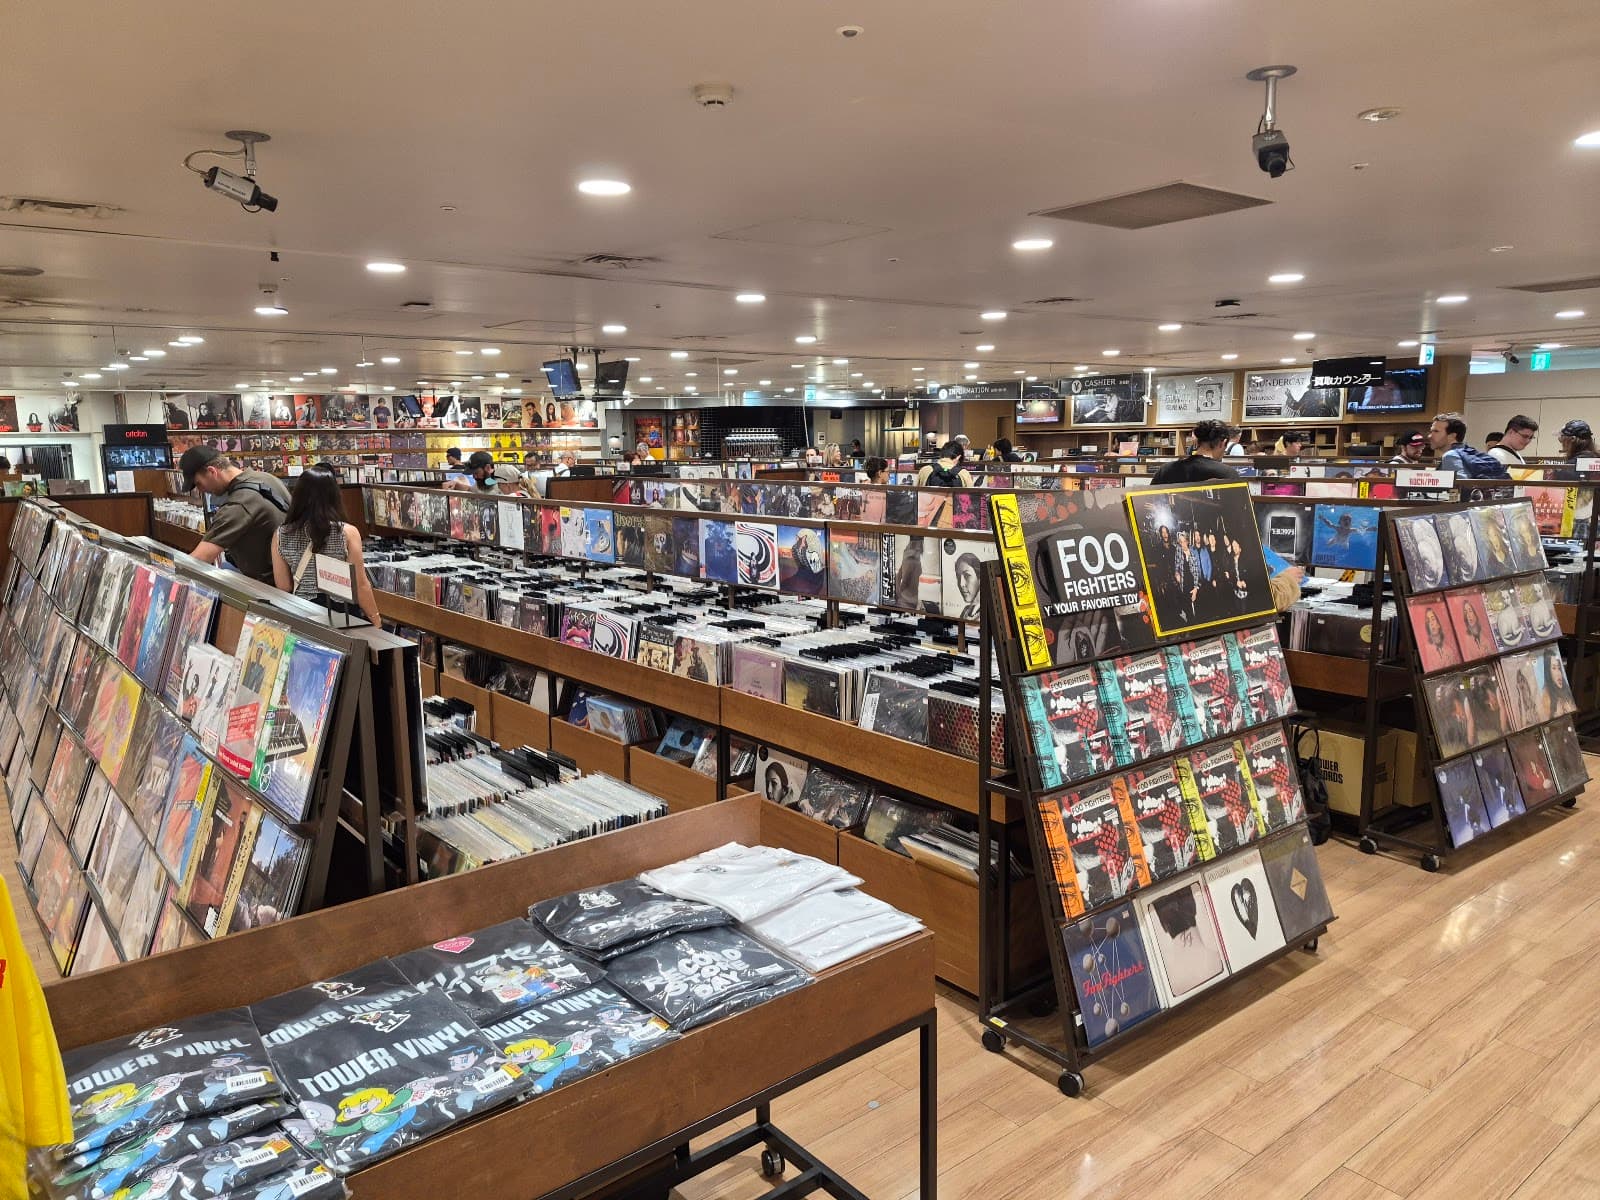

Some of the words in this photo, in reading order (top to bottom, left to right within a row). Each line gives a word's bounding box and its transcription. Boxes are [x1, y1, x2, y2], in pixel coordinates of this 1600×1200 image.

[1084, 379, 1116, 387] CASHIER
[1409, 478, 1440, 486] ROCK/POP
[1056, 532, 1130, 579] FOO
[1063, 571, 1137, 600] FIGHTERS
[1053, 600, 1080, 614] YOUR
[1081, 596, 1120, 612] FAVORITE
[1121, 593, 1138, 606] TOY
[1064, 673, 1090, 687] FIGHTERS
[1137, 781, 1149, 792] FOO
[1149, 772, 1173, 787] FIGHTERS
[1072, 803, 1083, 815] FOO
[1084, 793, 1111, 807] FIGHTERS
[693, 971, 742, 1000] DAY
[542, 988, 617, 1015] VINYL
[261, 1010, 345, 1047] TOWER
[162, 1038, 252, 1058] VINYL
[298, 1047, 398, 1098] TOWER
[392, 1021, 476, 1060] VINYL
